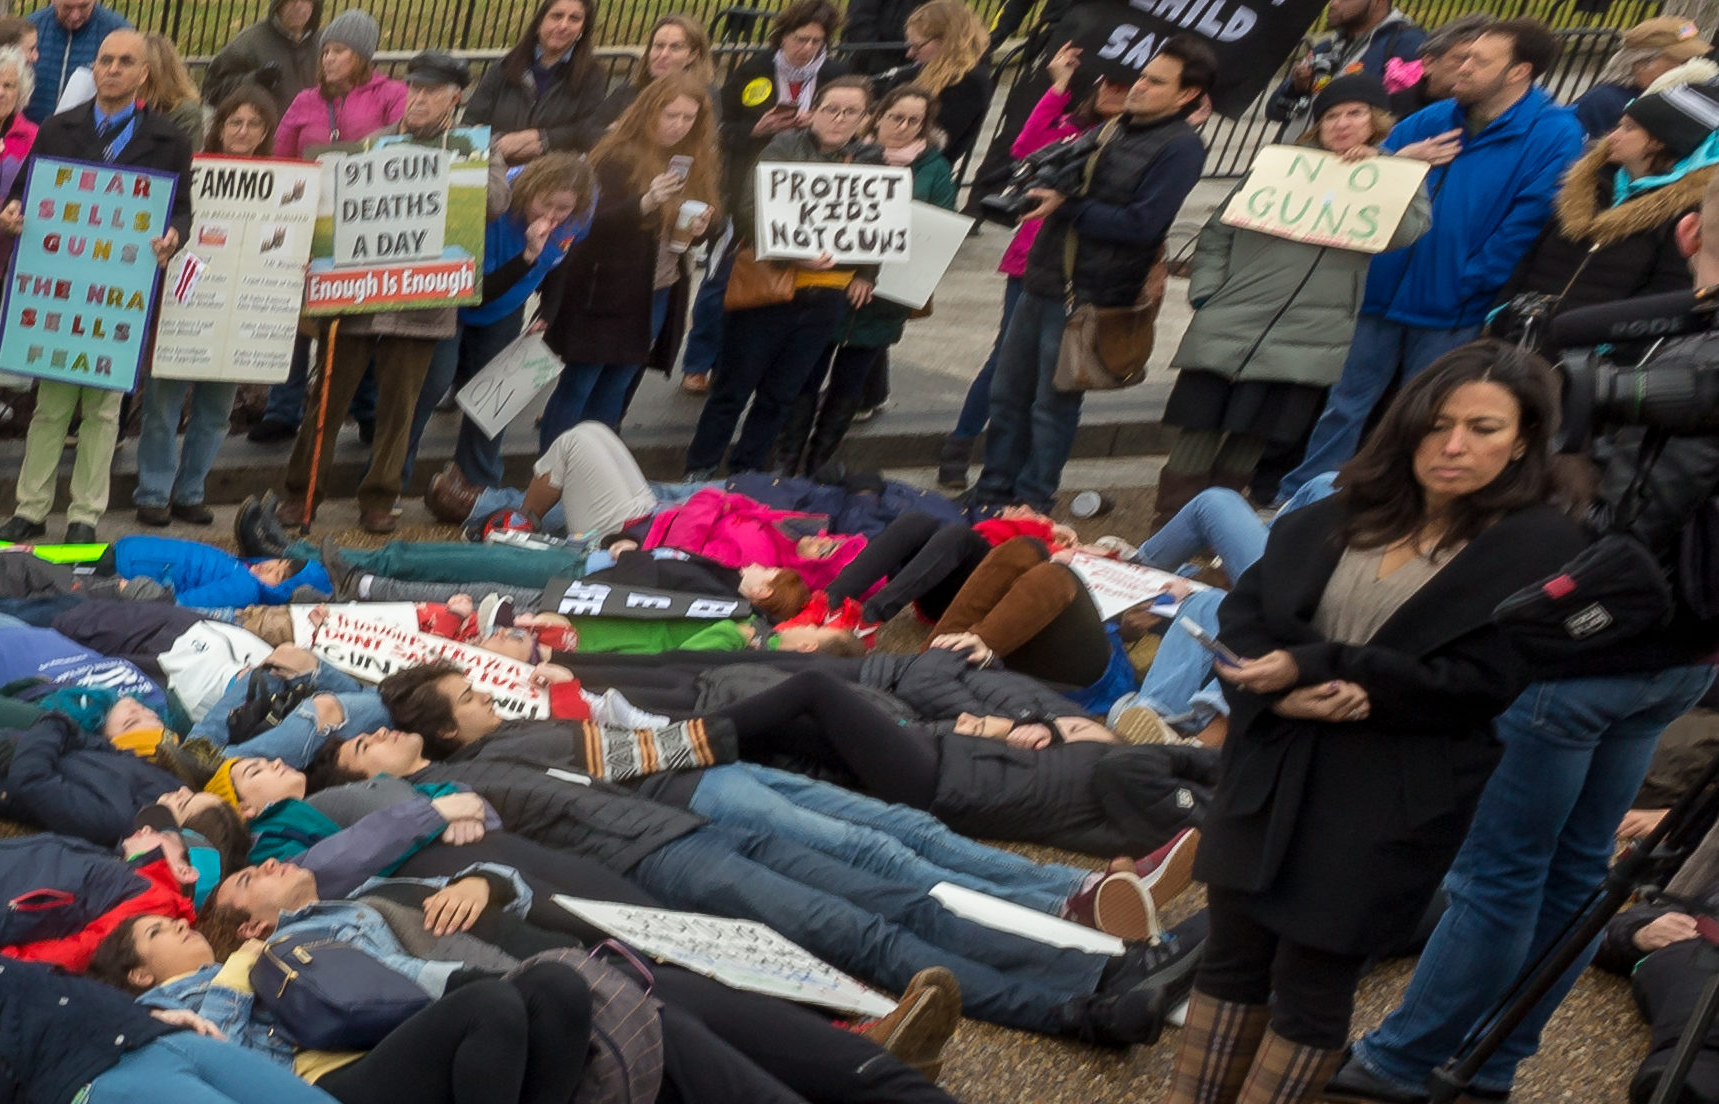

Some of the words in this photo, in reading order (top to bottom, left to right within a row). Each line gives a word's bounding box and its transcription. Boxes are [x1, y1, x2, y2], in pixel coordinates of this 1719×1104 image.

[1129, 0, 1258, 43] HILD
[53, 166, 152, 199] FEAR
[199, 168, 276, 200] AMMO
[344, 159, 374, 187] 91
[383, 154, 440, 182] GUN
[770, 168, 904, 201] PROTECT
[1286, 152, 1381, 192] NO
[37, 198, 152, 233] SELLS
[342, 191, 442, 224] DEATHS
[799, 200, 882, 226] KIDS
[1247, 186, 1381, 239] GUNS
[42, 232, 140, 265] GUNS
[351, 234, 368, 259] A
[377, 229, 429, 257] DAY
[771, 219, 829, 250] NOT
[833, 224, 908, 255] GUNS
[15, 272, 73, 301] THE
[86, 283, 146, 312] NRA
[309, 272, 379, 305] Enough
[382, 270, 399, 297] Is
[400, 263, 474, 298] Enough
[19, 307, 131, 343] SELLS
[25, 343, 113, 377] FEAR
